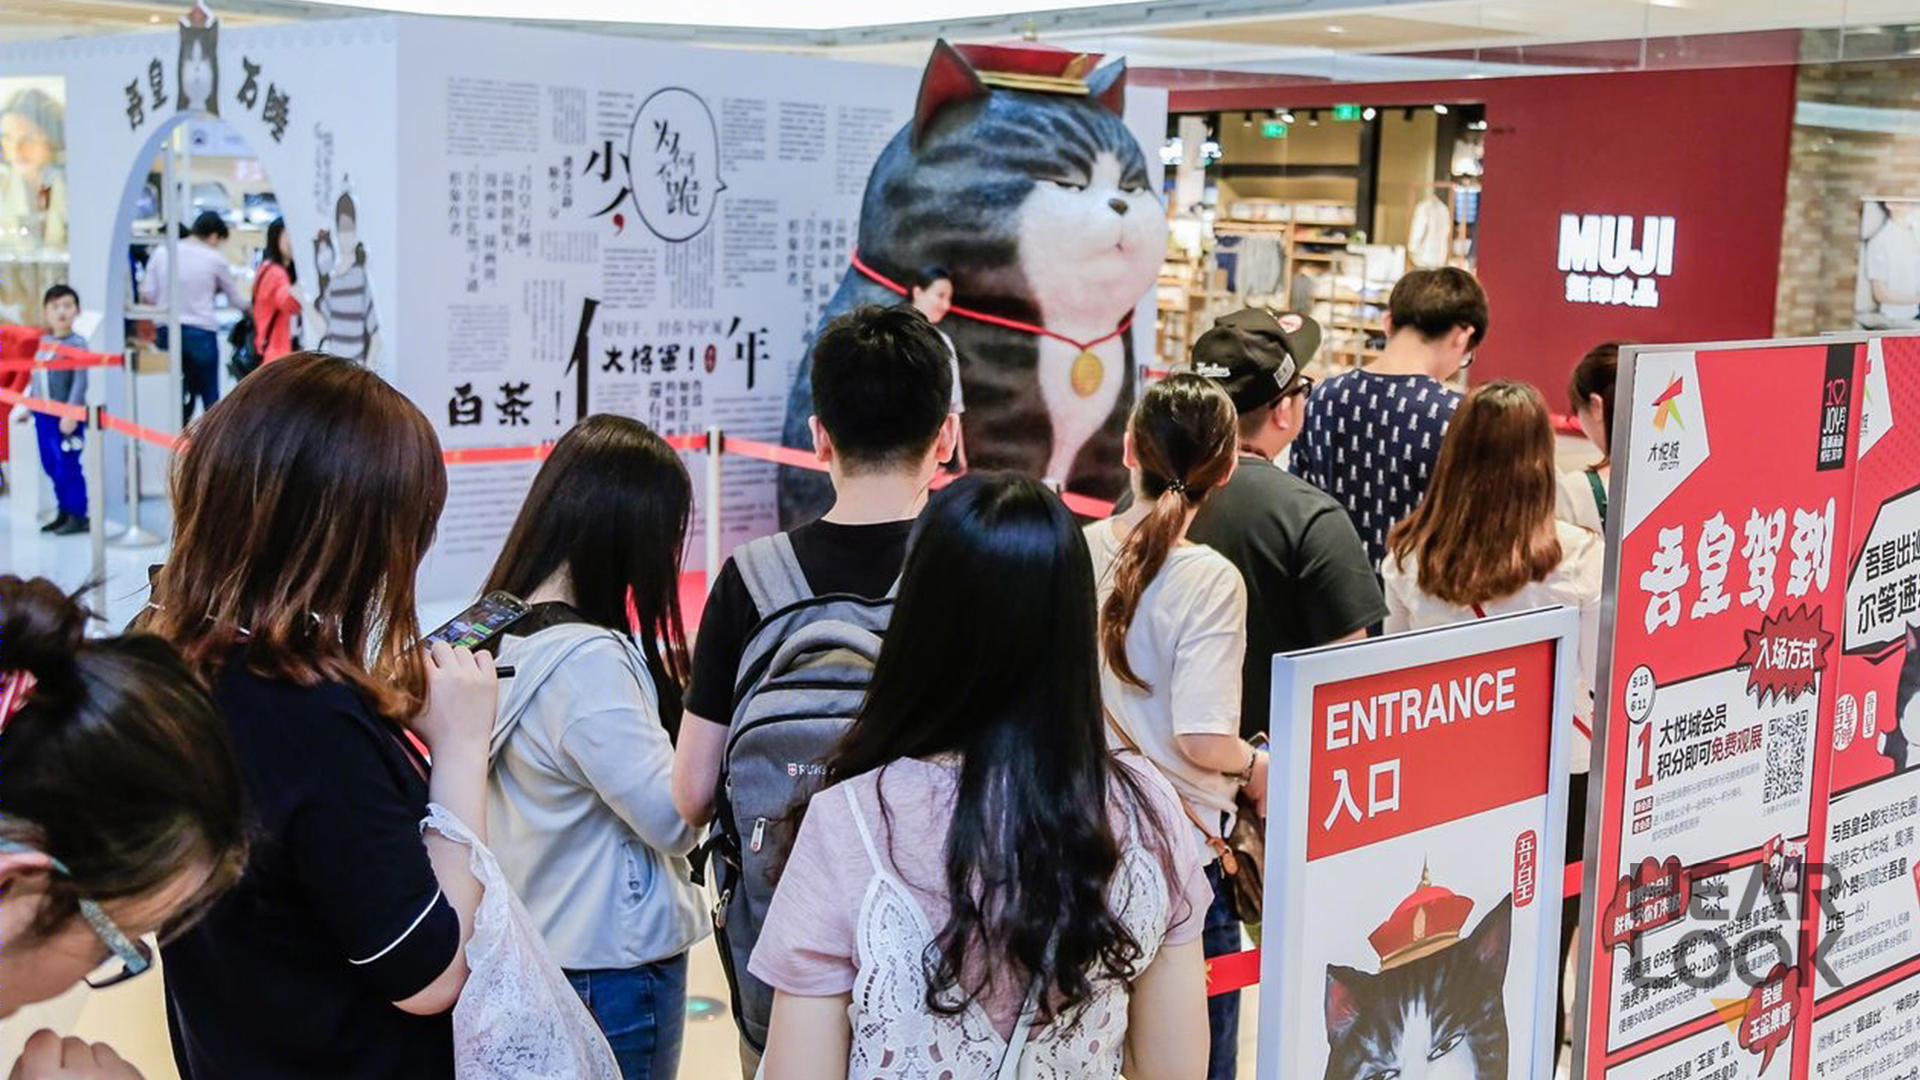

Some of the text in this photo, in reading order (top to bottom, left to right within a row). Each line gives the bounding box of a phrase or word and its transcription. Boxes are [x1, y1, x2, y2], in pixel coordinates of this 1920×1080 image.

[1558, 214, 1676, 276] MUJI
[1647, 441, 1680, 462] 大悦城
[1640, 497, 1835, 634] 吾皇驾到
[1857, 573, 1920, 634] 尔等速
[1756, 637, 1817, 669] 入场方式
[1326, 667, 1517, 750] ENTRANCE
[1659, 704, 1727, 748] 大悦城会员
[1635, 721, 1653, 790] 1
[1657, 724, 1763, 781] 积分即可免费观展
[1324, 758, 1400, 830] 入口
[1516, 835, 1534, 903] 吾皇
[1762, 979, 1783, 1009] 吾皇
